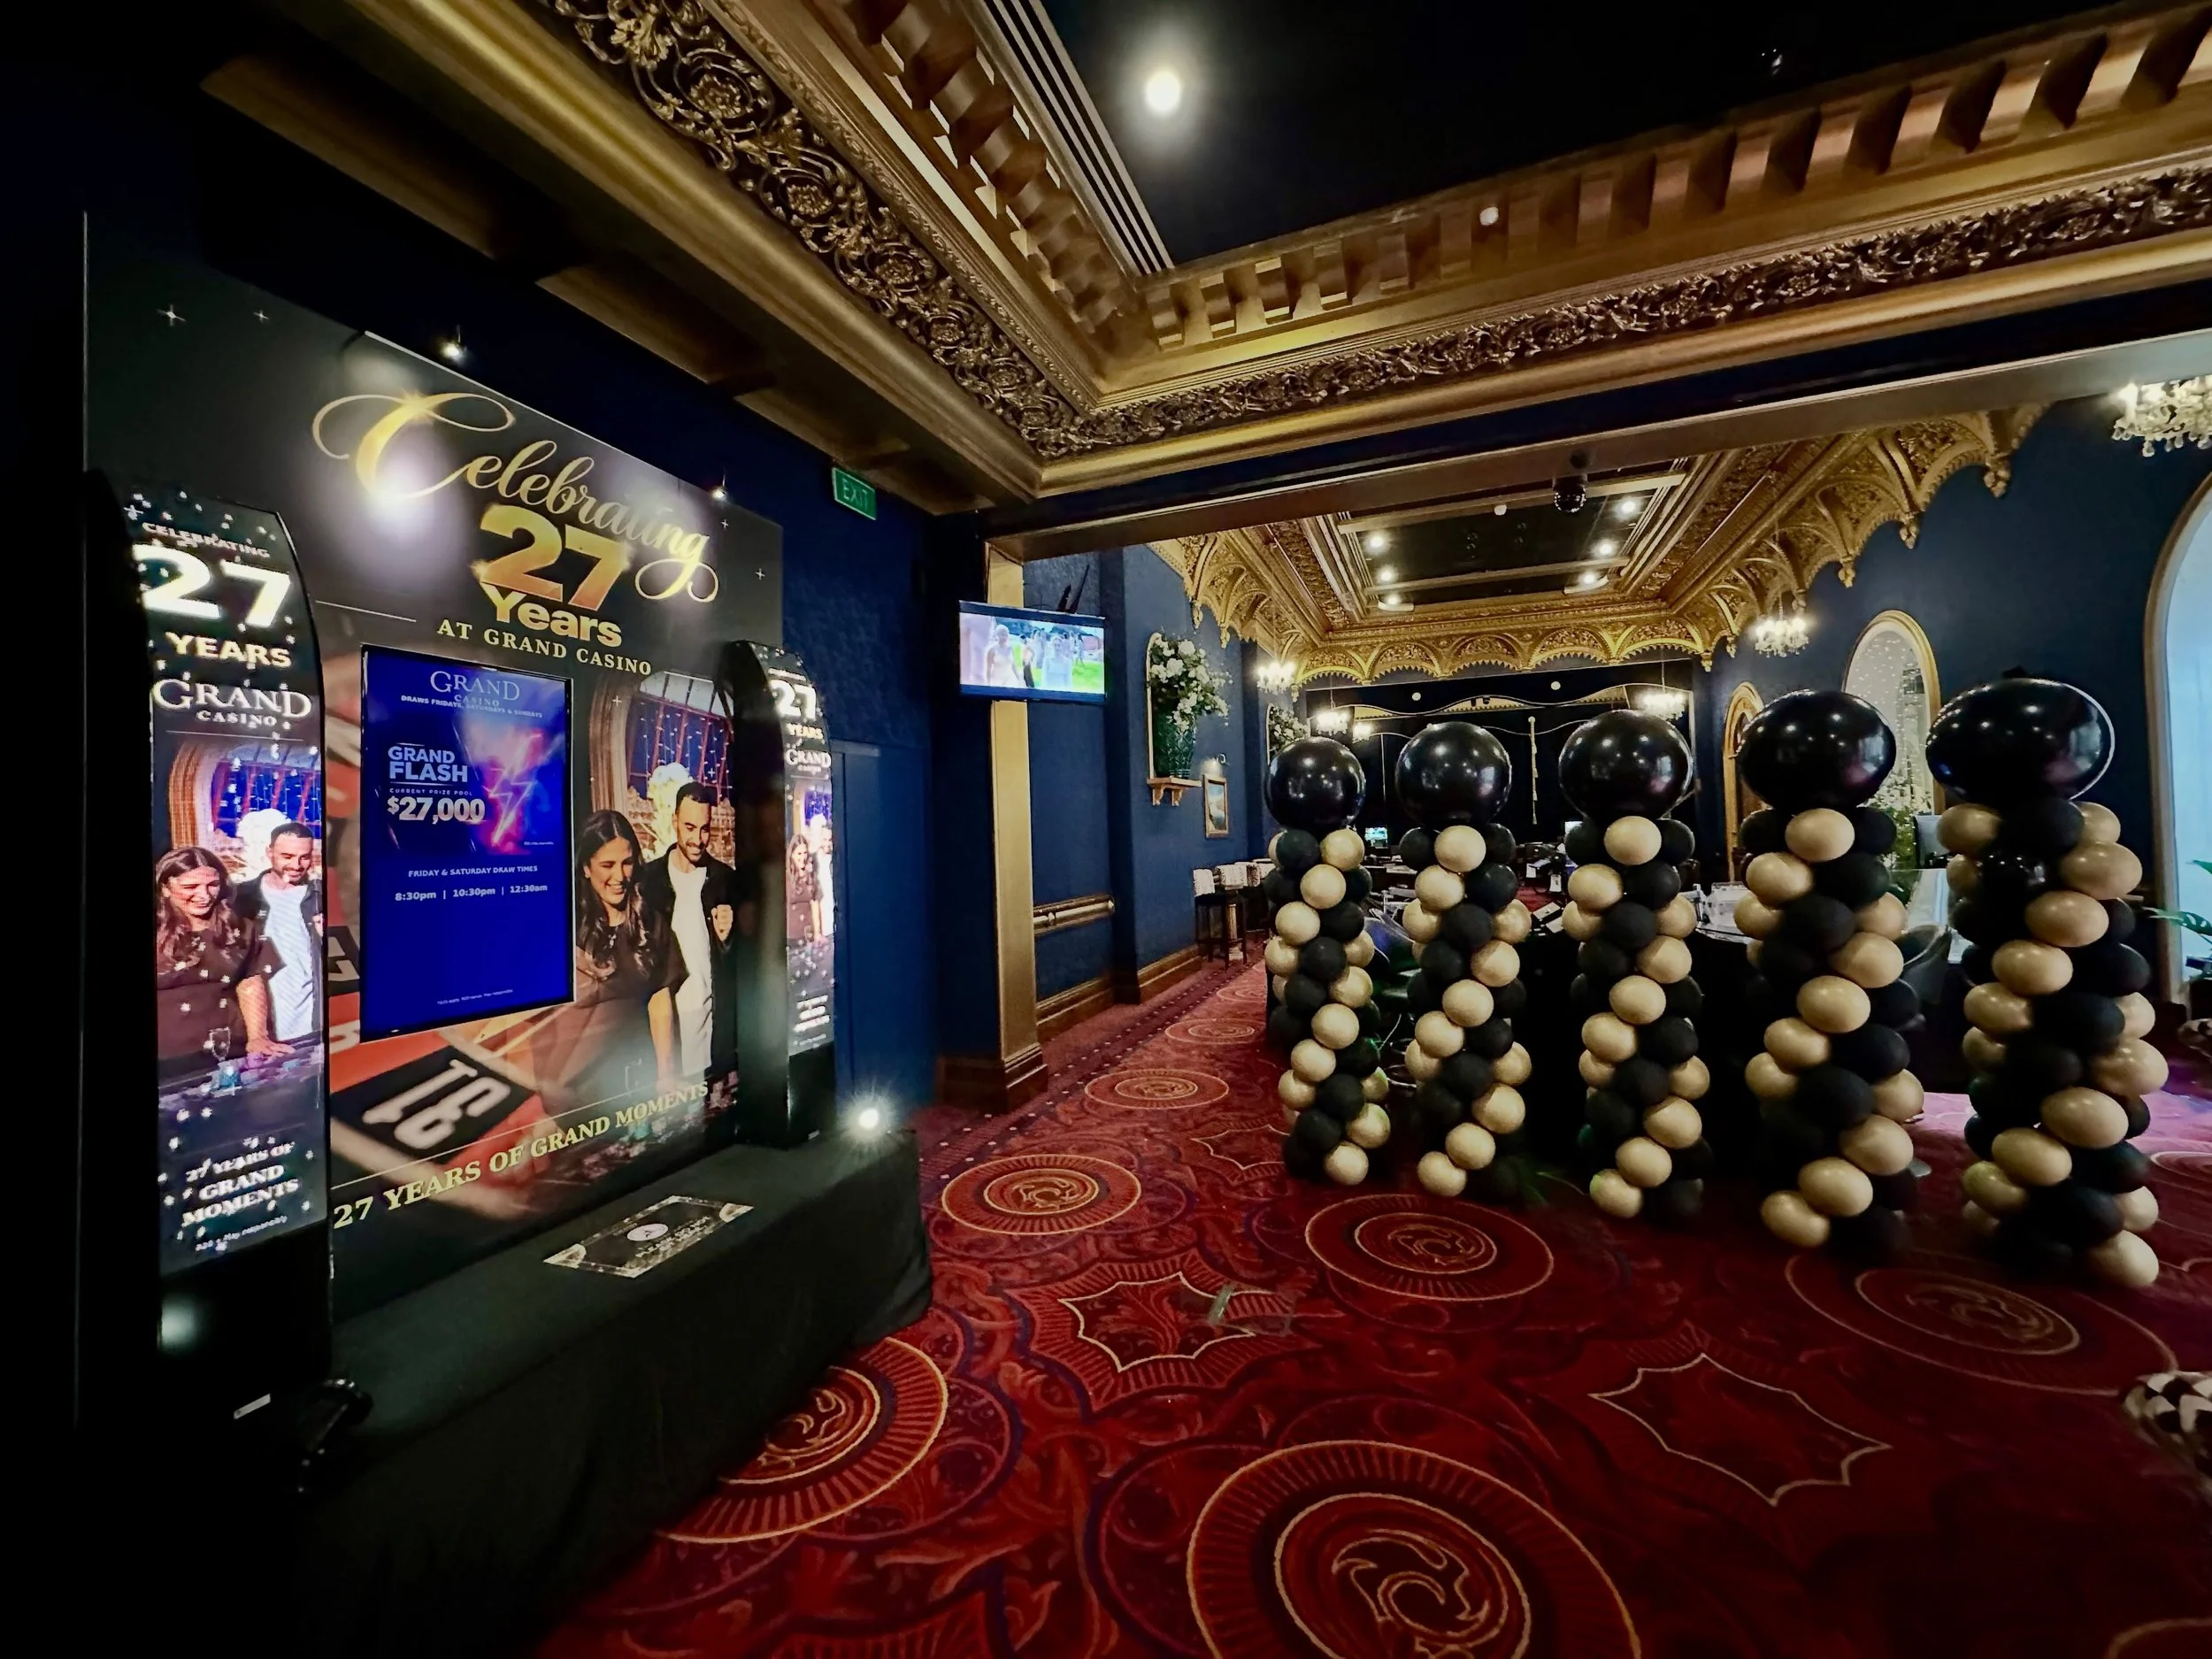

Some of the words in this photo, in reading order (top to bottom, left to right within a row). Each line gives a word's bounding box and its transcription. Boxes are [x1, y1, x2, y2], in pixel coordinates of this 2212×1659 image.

[311, 392, 718, 603] Celebrating
[842, 478, 868, 511] EXIT
[142, 522, 270, 558] CELEBRATING
[478, 504, 623, 611] 27
[133, 543, 291, 627] 27
[479, 581, 622, 647] Years
[165, 631, 292, 668] YEARS
[436, 619, 473, 640] AT
[483, 628, 567, 658] GRAND
[576, 648, 652, 676] CASINO
[150, 678, 311, 718] GRAND
[401, 695, 429, 704] DRAWS
[430, 671, 520, 701] GRAND
[454, 694, 500, 707] CASINO
[769, 679, 817, 721] 27
[196, 710, 278, 726] CASINO
[388, 746, 455, 764] GRAND
[388, 762, 468, 782] FLASH
[786, 749, 832, 768] GRAND
[387, 795, 485, 825] $27,000
[408, 869, 440, 878] FRIDAY
[449, 867, 492, 876] SATURDAY
[395, 891, 437, 902] 8:30pm
[453, 887, 495, 898] 10:30pm
[510, 884, 548, 894] 12:30am
[212, 1149, 269, 1174] YEARS
[333, 1195, 374, 1229] 27
[382, 1160, 481, 1211] YEARS
[488, 1145, 525, 1173] OF
[531, 1117, 611, 1158] GRAND
[615, 1080, 709, 1127] MOMENTS
[198, 1164, 285, 1201] GRAND
[181, 1179, 299, 1228] MOMENTS
